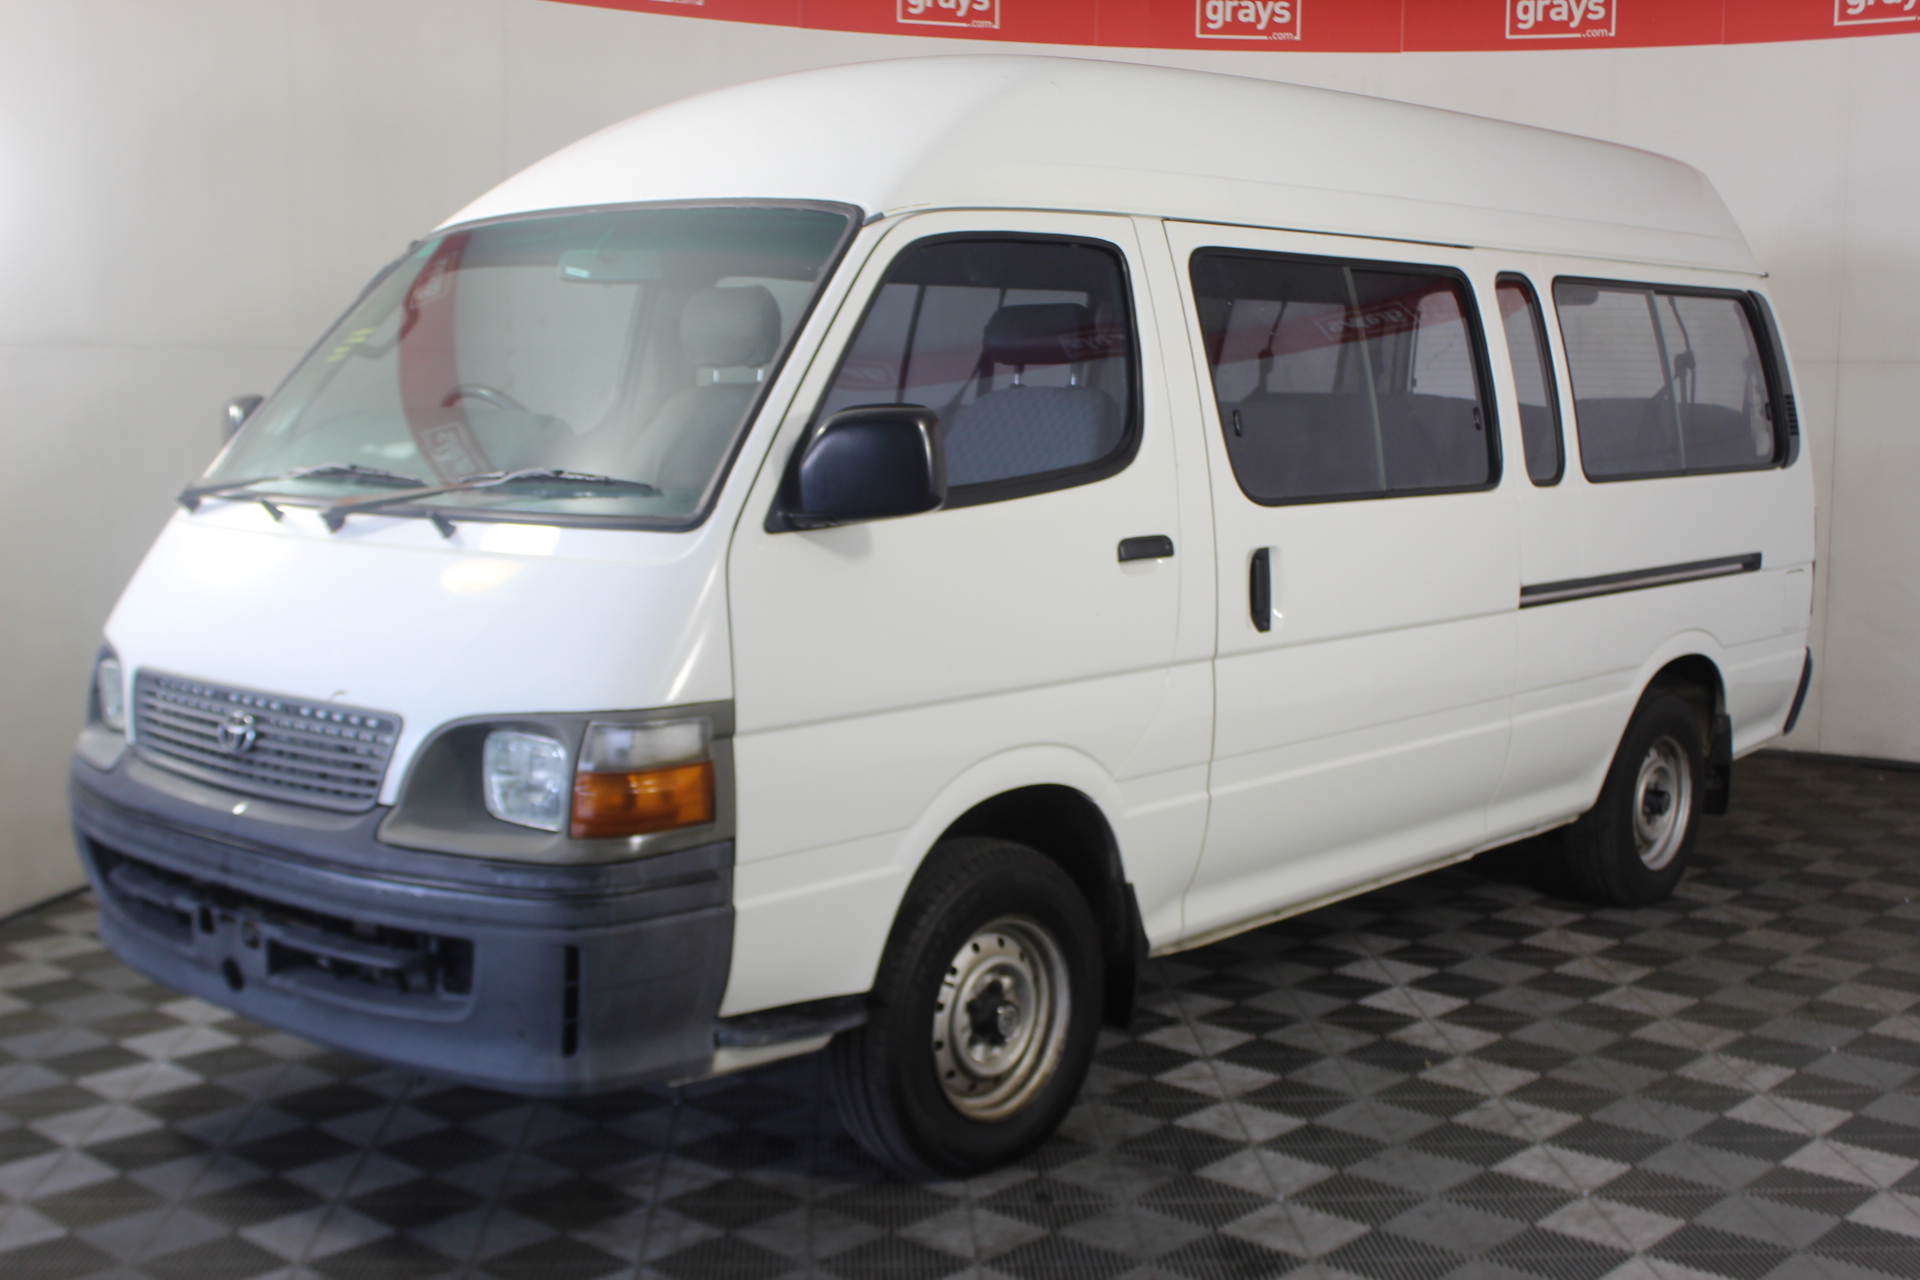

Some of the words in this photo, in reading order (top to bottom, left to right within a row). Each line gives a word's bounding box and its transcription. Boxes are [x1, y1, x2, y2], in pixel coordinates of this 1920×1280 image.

[1205, 0, 1291, 30] grays
[1516, 0, 1606, 30] grays
[1581, 28, 1608, 38] .com
